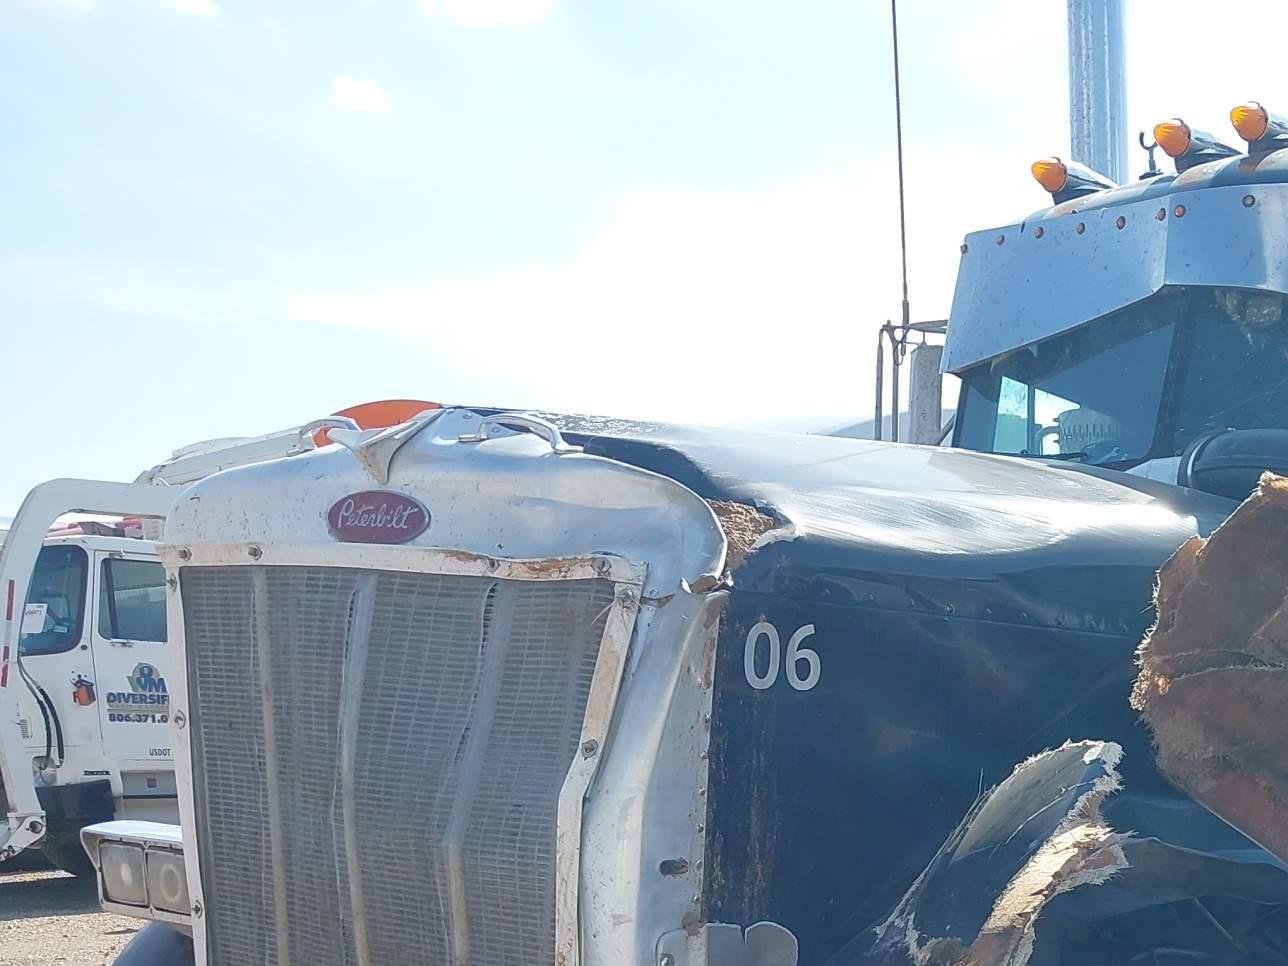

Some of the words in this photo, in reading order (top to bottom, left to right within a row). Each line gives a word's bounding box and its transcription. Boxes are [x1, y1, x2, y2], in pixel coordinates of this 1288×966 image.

[337, 499, 419, 529] Peterbilt
[743, 621, 821, 691] 06
[149, 748, 171, 757] USDOT
